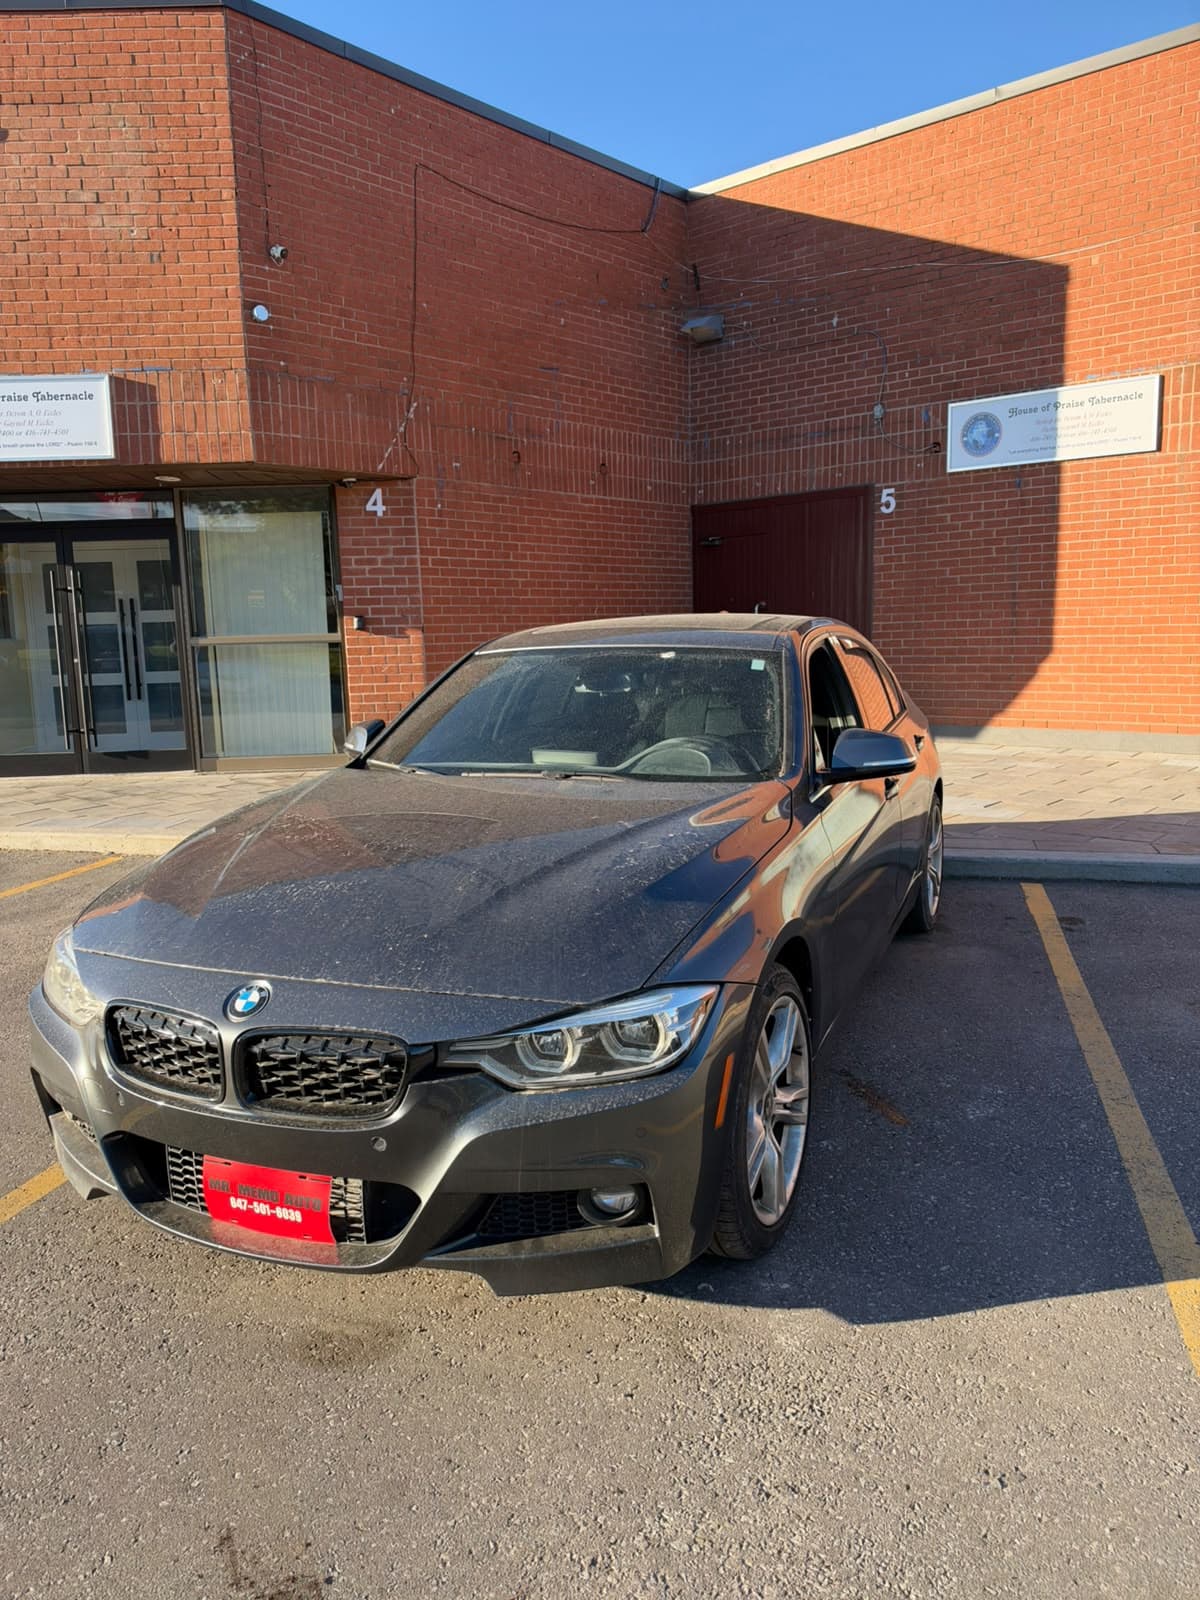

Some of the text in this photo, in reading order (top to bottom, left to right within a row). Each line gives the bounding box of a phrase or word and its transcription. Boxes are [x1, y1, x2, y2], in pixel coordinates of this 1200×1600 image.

[32, 390, 94, 402] Tabernacle
[1008, 407, 1038, 418] House
[1041, 402, 1053, 412] of
[1053, 399, 1085, 412] Praise
[1088, 391, 1143, 406] Tabernacle
[366, 488, 386, 517] 4
[880, 487, 896, 514] 5
[229, 1196, 302, 1223] 647-501-6039
[238, 1184, 280, 1203] MEMO
[284, 1193, 322, 1212] AUTO
